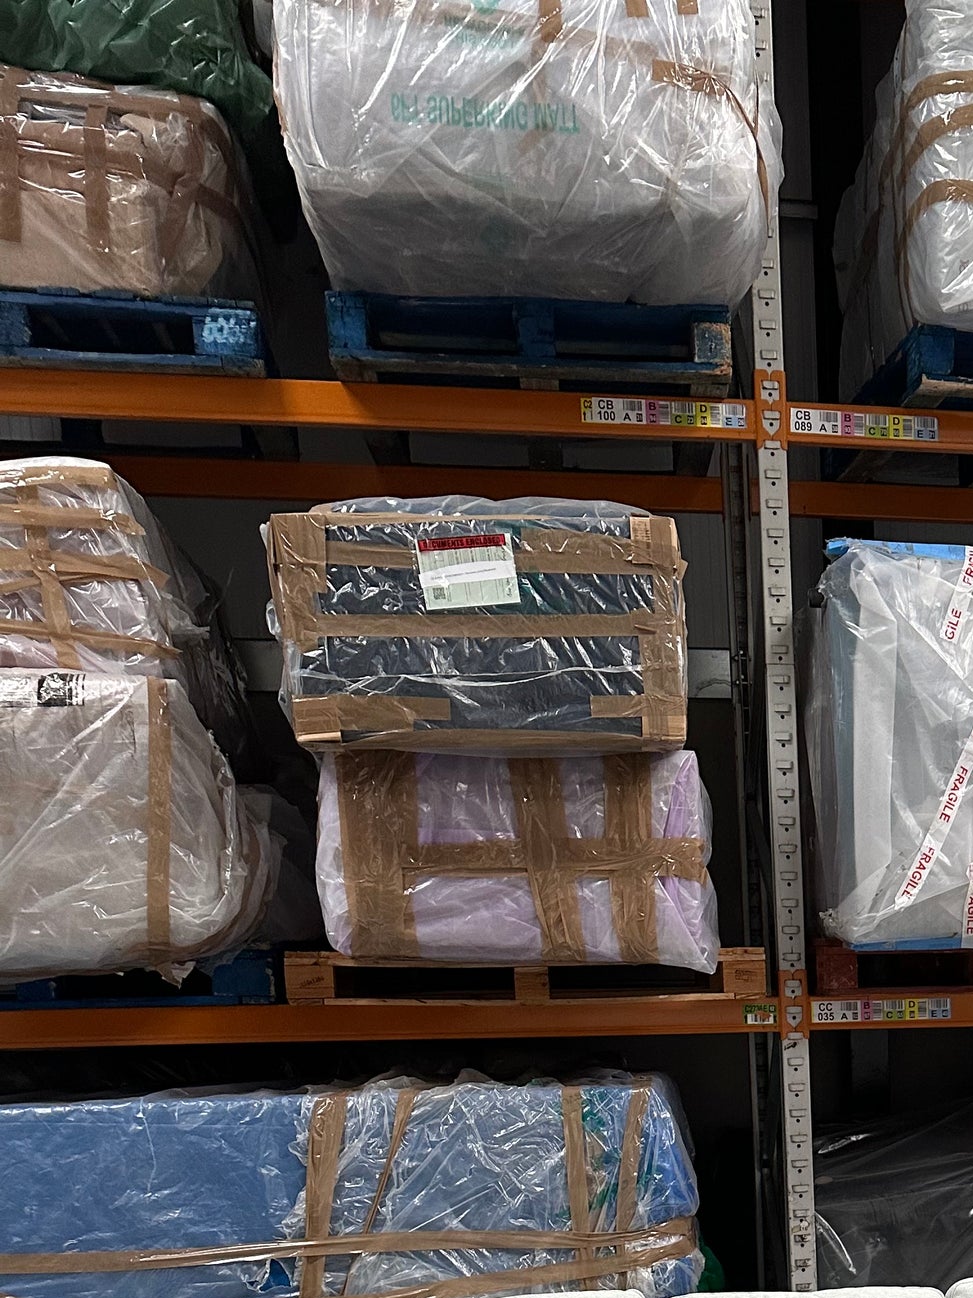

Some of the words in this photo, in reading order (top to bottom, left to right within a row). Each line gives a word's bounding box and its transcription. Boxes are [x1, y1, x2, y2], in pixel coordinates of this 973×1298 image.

[598, 400, 614, 410] CB
[598, 411, 616, 421] 100
[623, 412, 632, 422] A
[648, 402, 657, 411] B
[674, 415, 683, 424] C
[700, 404, 708, 413] D
[795, 410, 811, 421] CB
[794, 421, 812, 431] 089
[819, 424, 828, 432] A
[844, 413, 852, 422] B
[868, 427, 876, 436] C
[893, 417, 901, 425] D
[917, 429, 925, 438] E
[422, 539, 465, 550] DCUMENTS
[939, 765, 969, 823] FRAGILE
[817, 1013, 834, 1021] 035
[863, 1001, 870, 1009] B
[886, 1011, 893, 1019] C
[931, 1010, 937, 1018] E
[818, 1002, 833, 1012] CC
